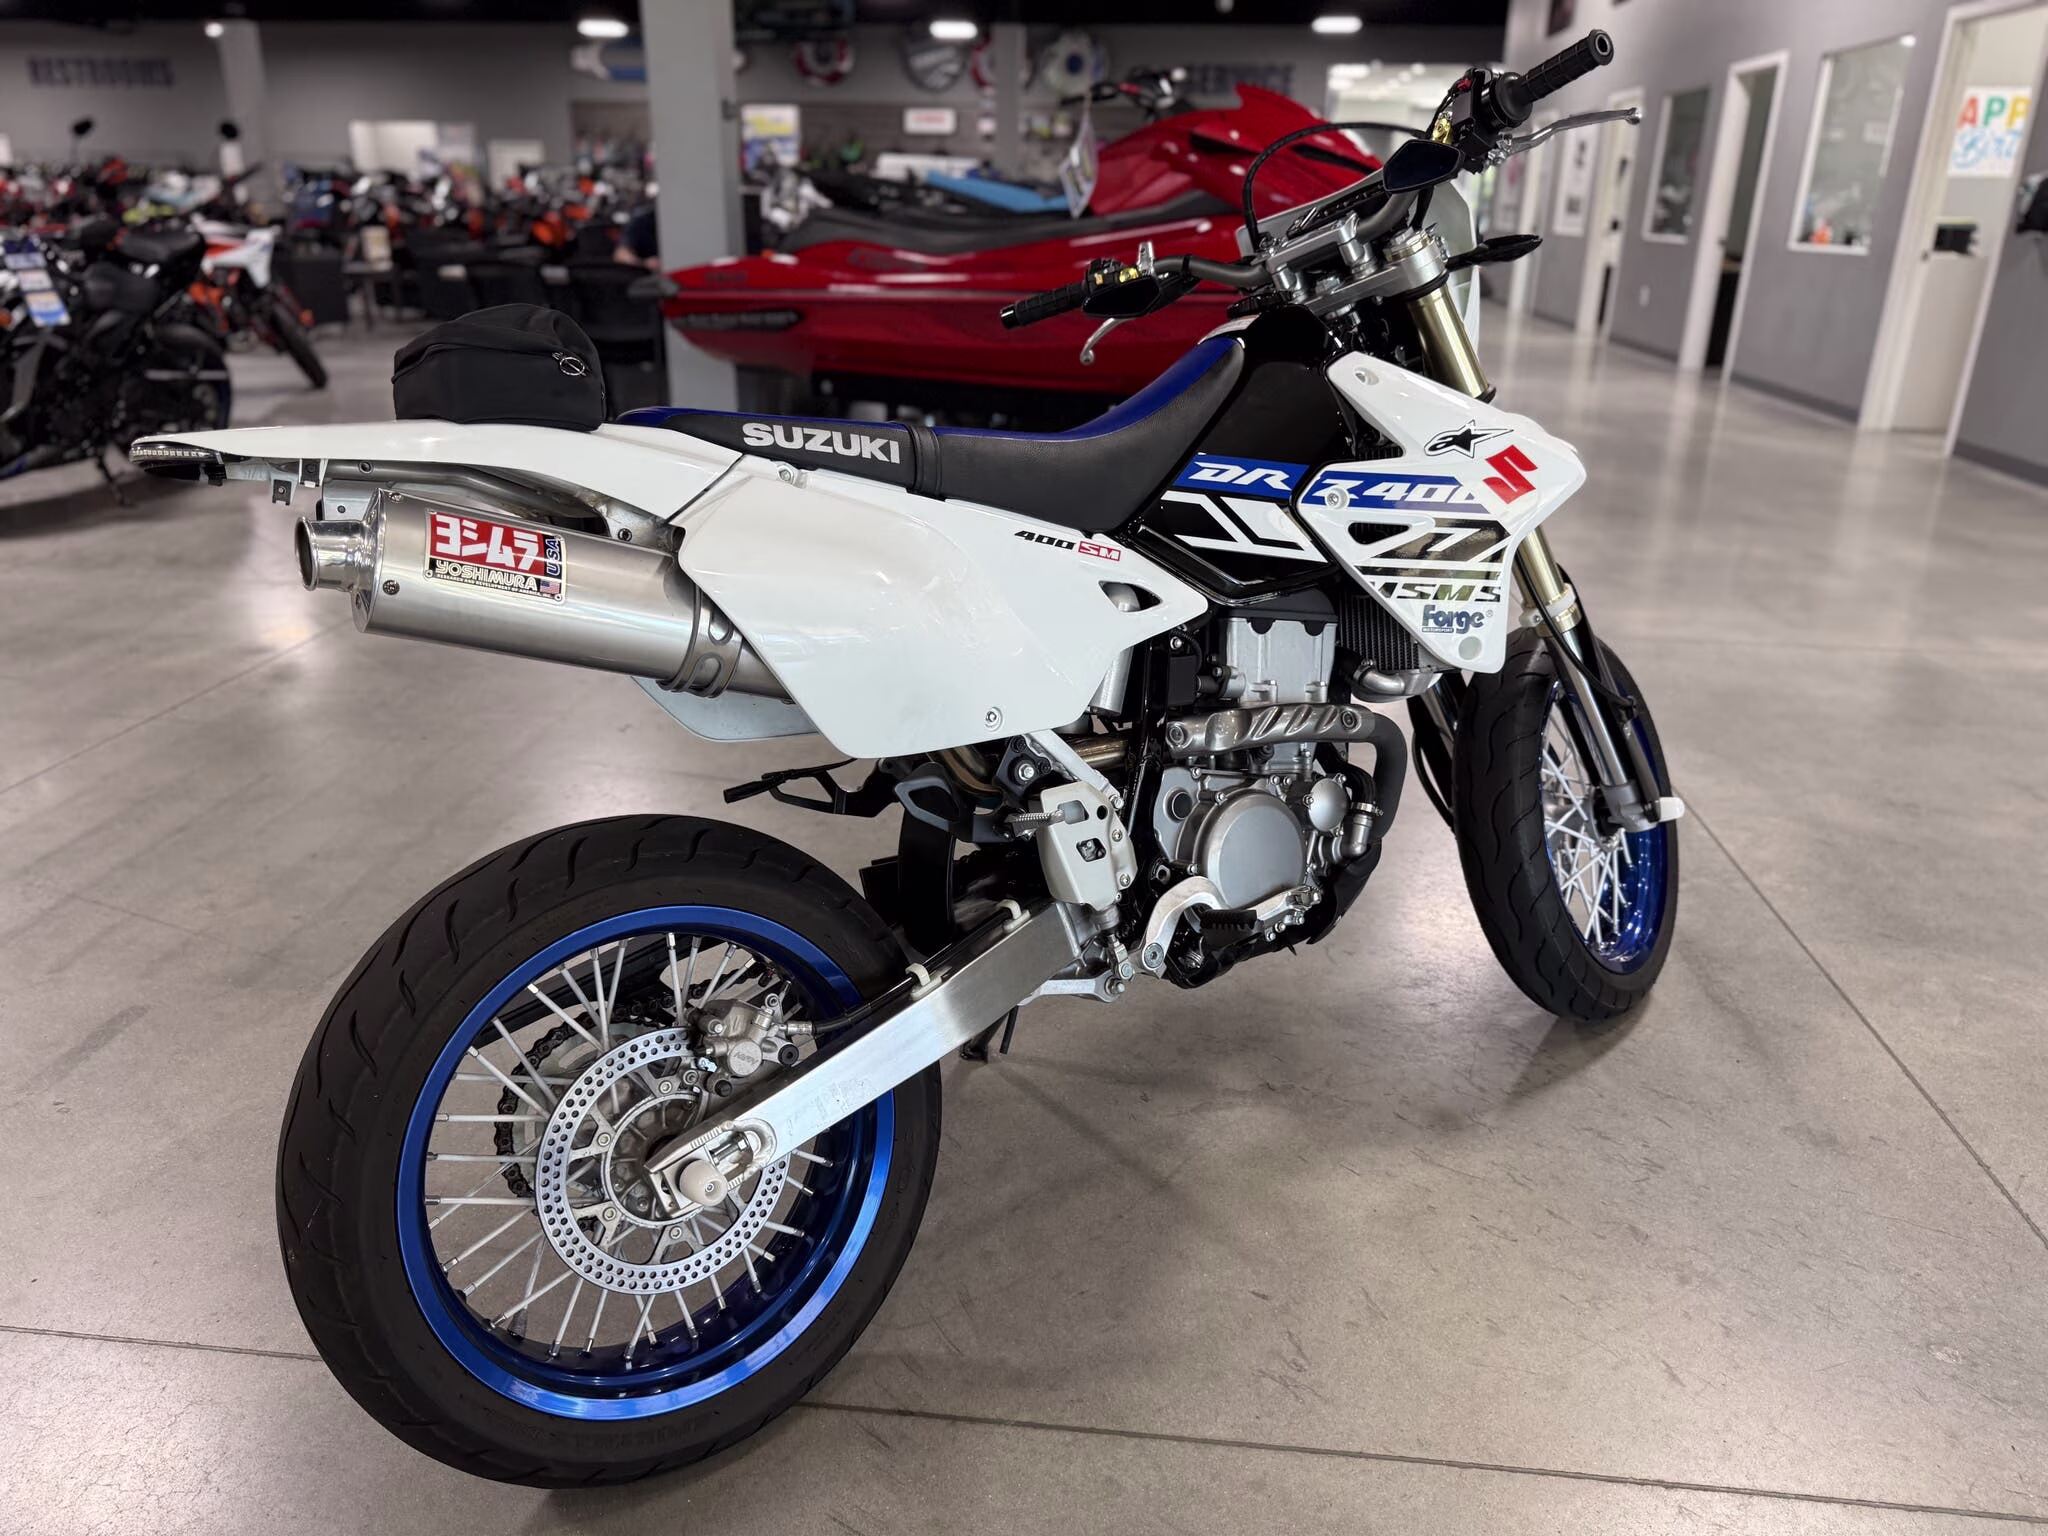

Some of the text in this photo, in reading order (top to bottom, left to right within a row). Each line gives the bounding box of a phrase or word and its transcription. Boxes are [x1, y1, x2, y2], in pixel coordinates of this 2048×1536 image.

[742, 422, 901, 464] SUZUKI
[1188, 461, 1292, 491] DR
[436, 514, 539, 571] ヨシムラ
[545, 538, 560, 576] USA
[1014, 530, 1120, 561] 400 SM
[435, 559, 538, 592] YOSHIMURA
[1422, 605, 1485, 634] Forge
